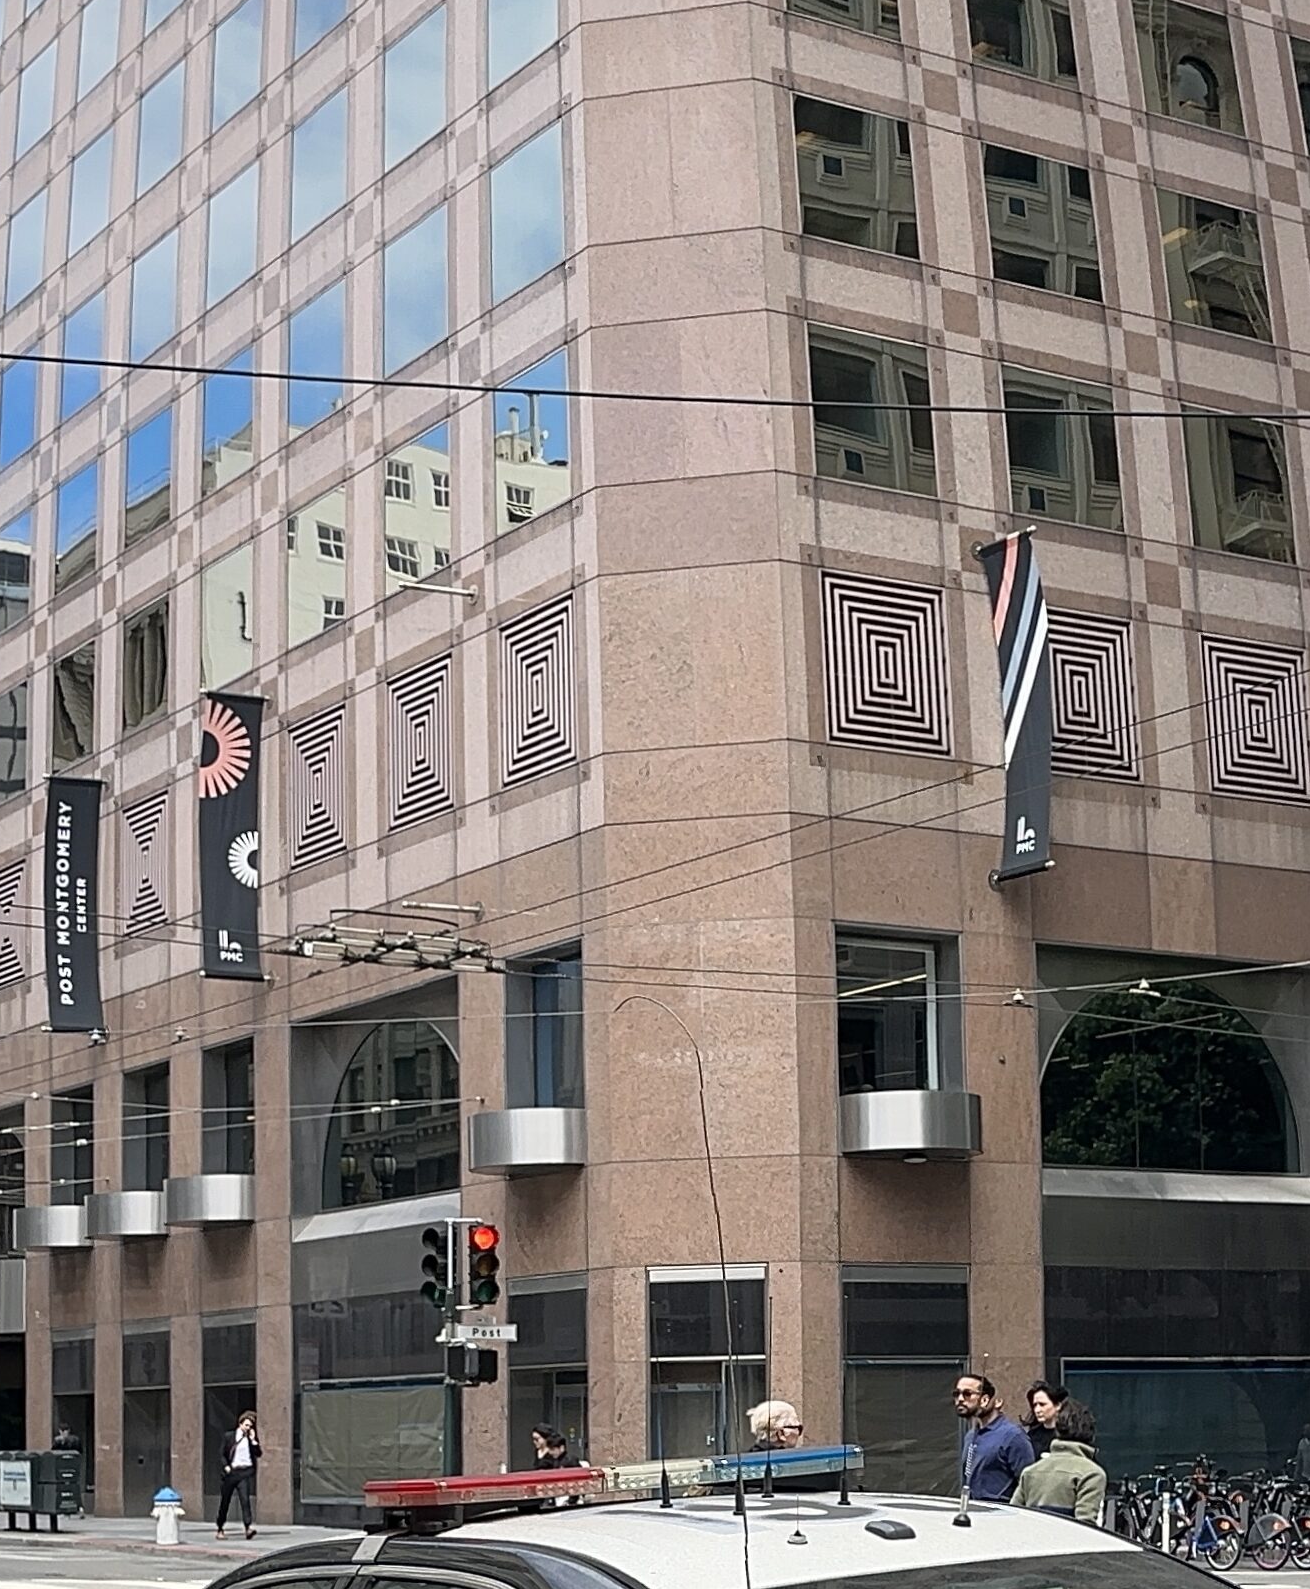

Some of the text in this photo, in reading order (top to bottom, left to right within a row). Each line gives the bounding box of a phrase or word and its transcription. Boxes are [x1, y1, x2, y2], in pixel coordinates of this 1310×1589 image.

[1015, 839, 1036, 855] PMC
[55, 800, 75, 1006] POST MONTGOMERY
[76, 877, 87, 934] CENTER
[219, 950, 244, 963] PMC
[472, 1327, 501, 1337] Post
